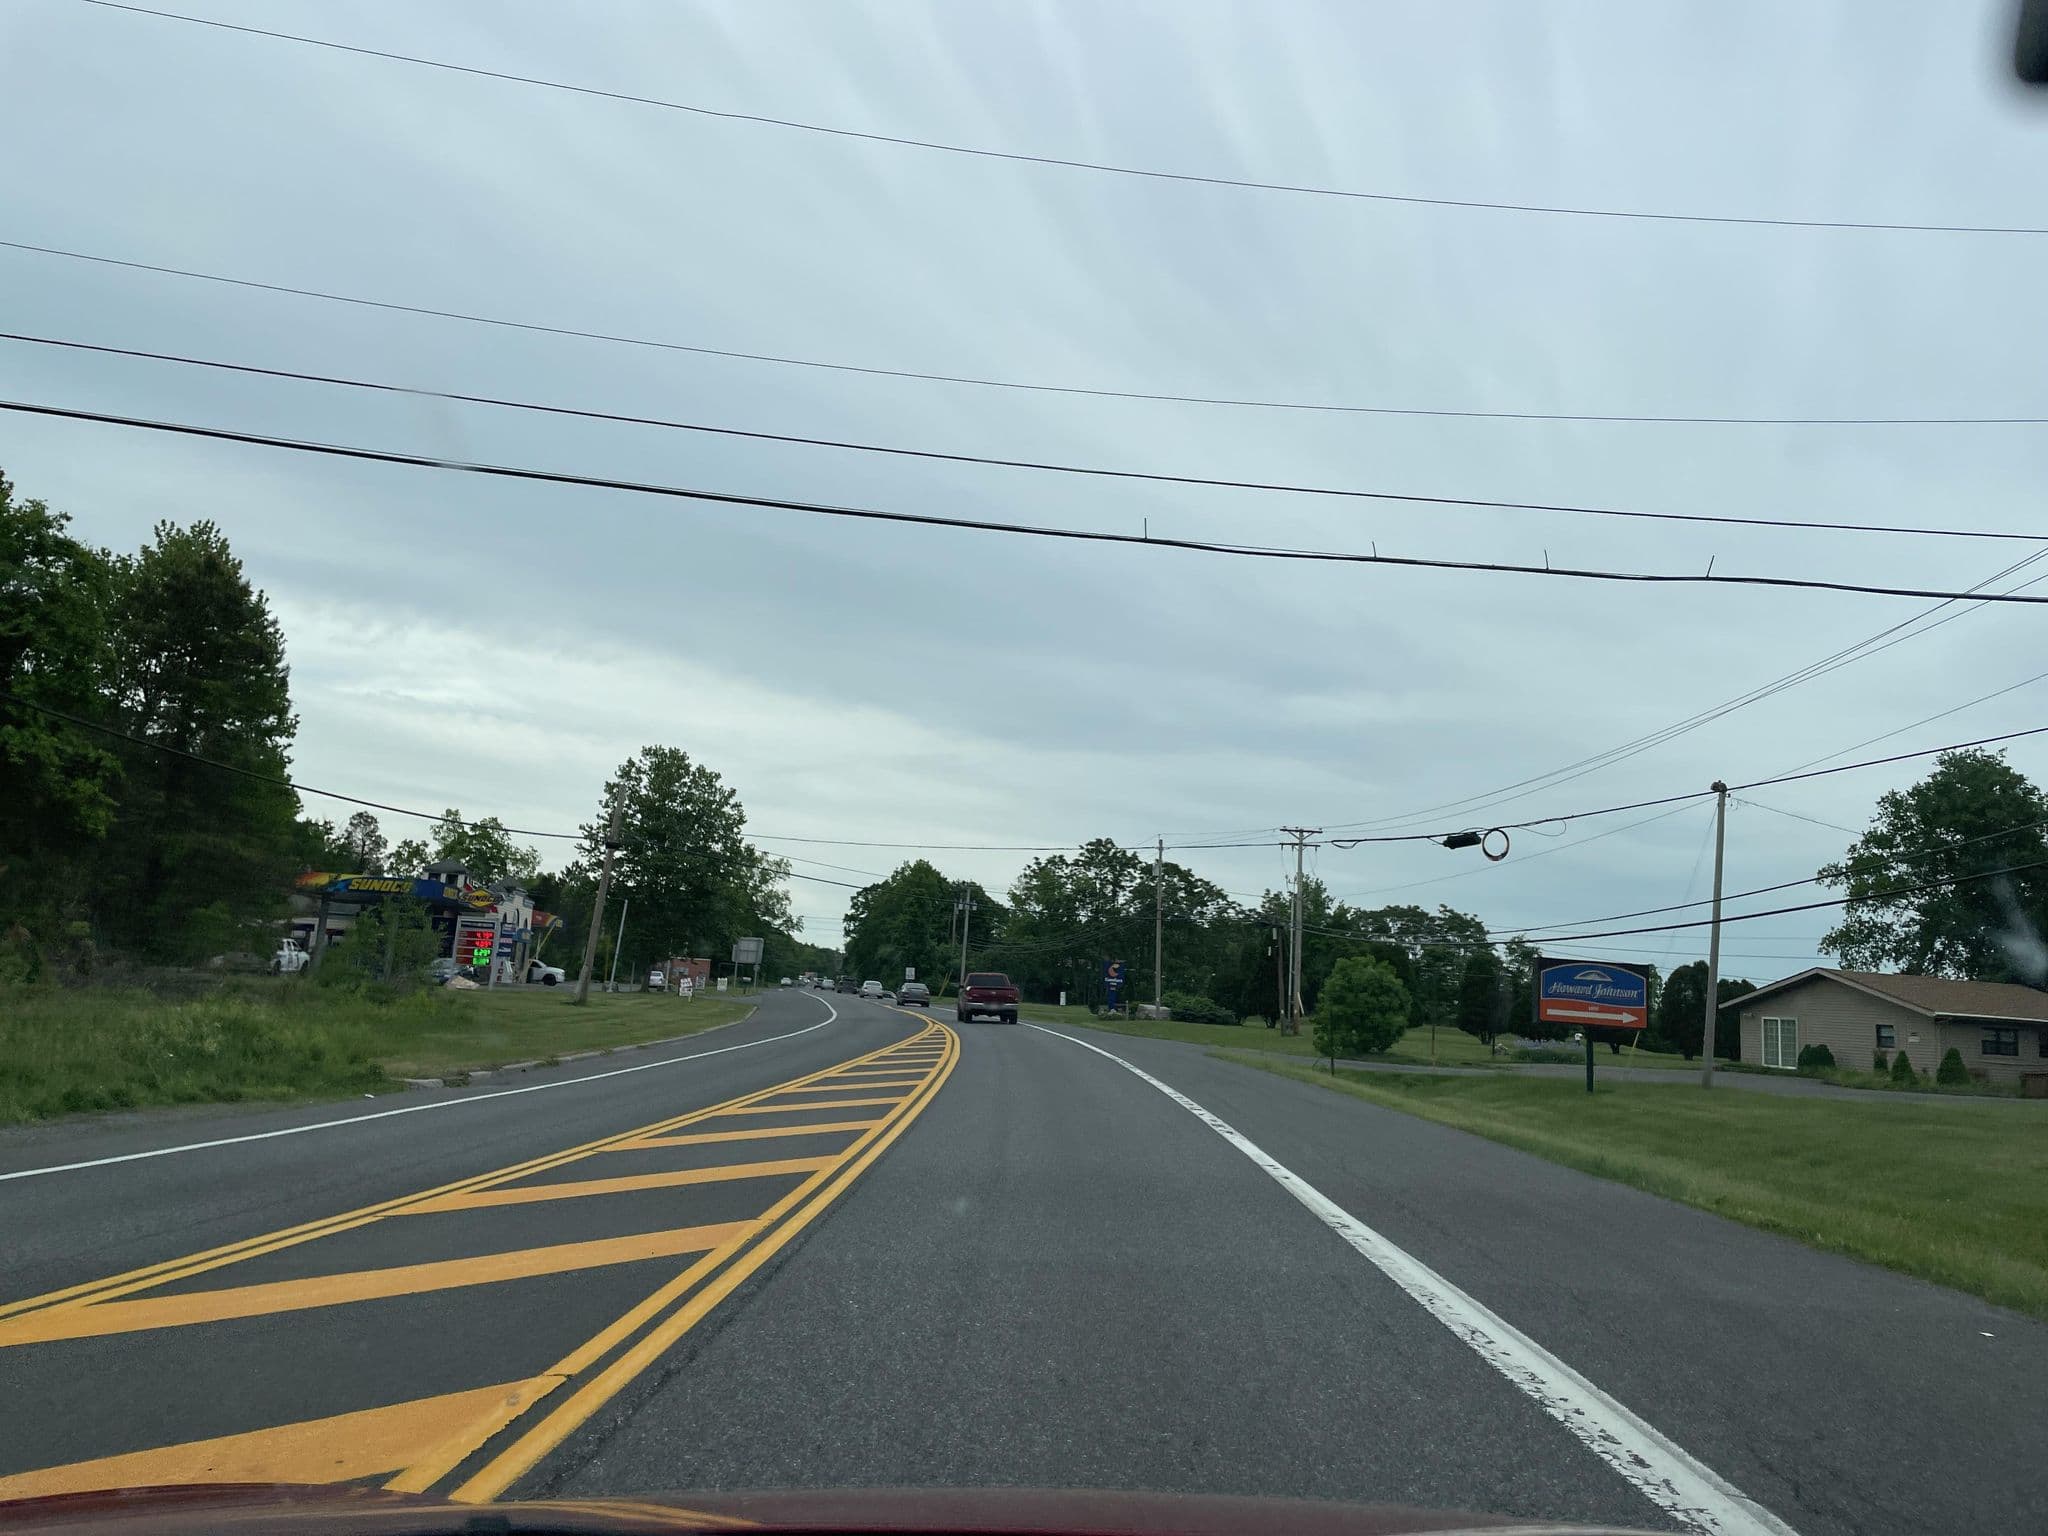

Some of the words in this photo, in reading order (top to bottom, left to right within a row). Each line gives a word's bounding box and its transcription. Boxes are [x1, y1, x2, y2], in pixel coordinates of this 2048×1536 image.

[348, 878, 412, 893] SUNOCO
[462, 893, 501, 904] SUNOCO
[1548, 981, 1593, 995] Howard
[1592, 984, 1637, 999] Johnson
